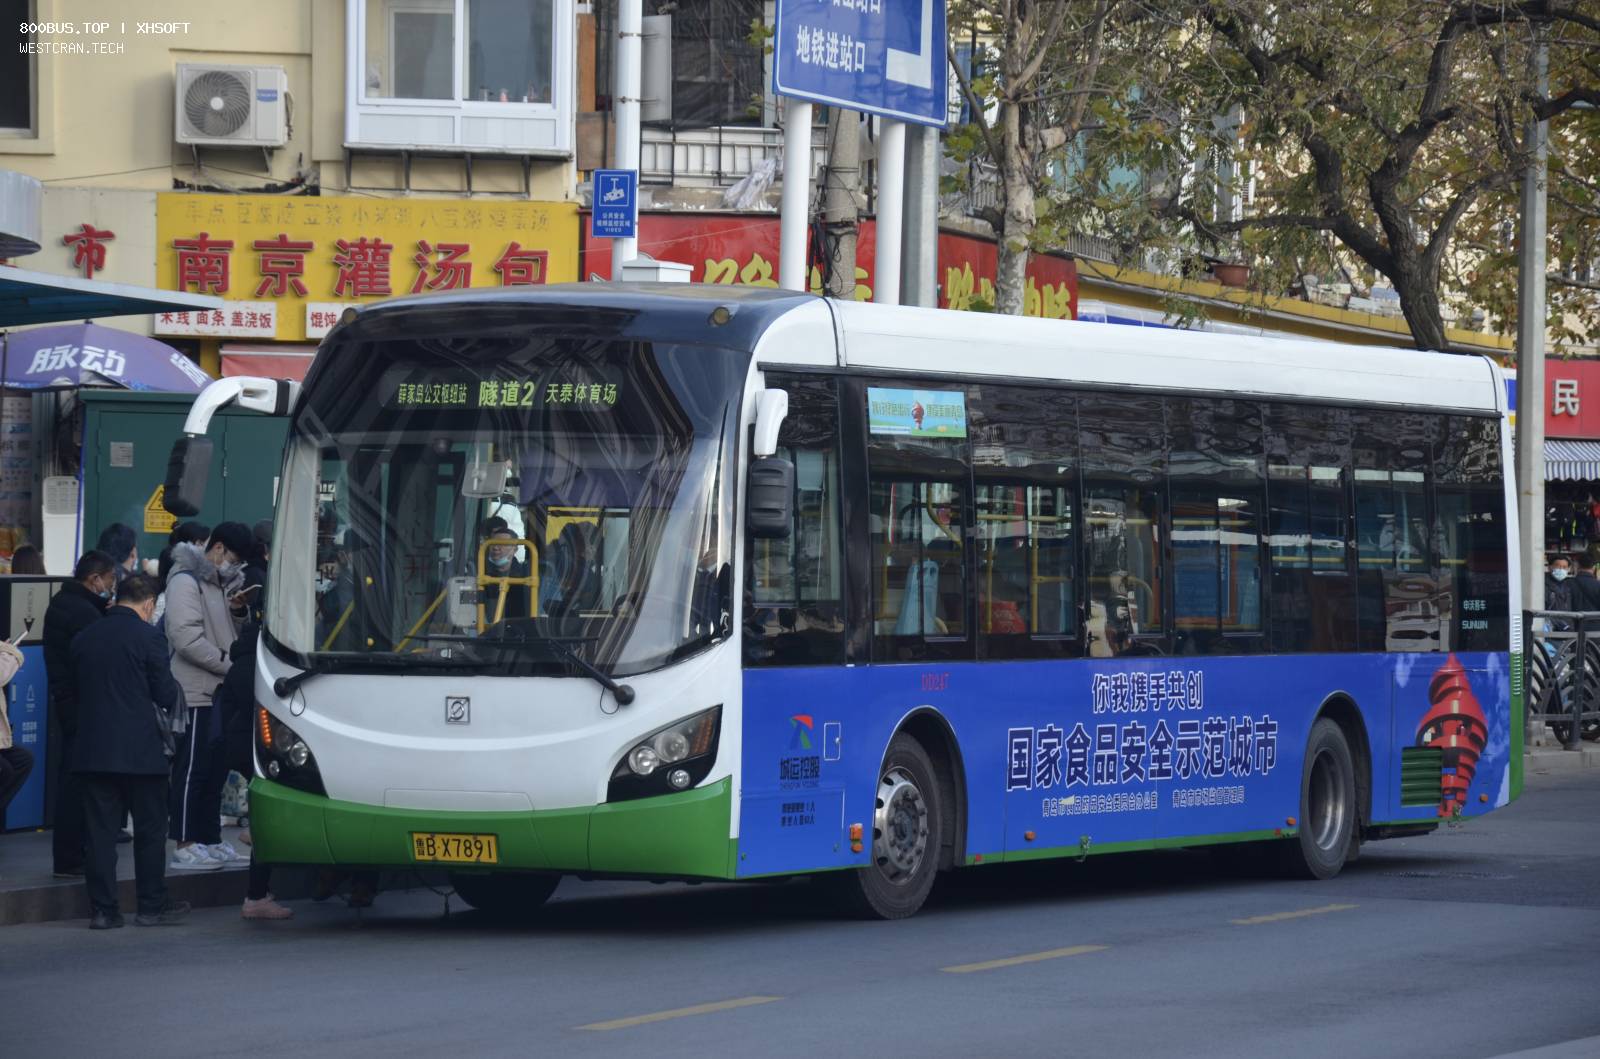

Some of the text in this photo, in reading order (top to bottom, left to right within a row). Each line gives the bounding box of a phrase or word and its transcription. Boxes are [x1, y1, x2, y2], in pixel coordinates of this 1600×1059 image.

[796, 24, 866, 73] 地铁进站口
[62, 223, 116, 280] 市
[172, 231, 549, 298] 南京灌汤包
[196, 309, 226, 327] 面条
[231, 311, 272, 329] 盖浇饭
[26, 343, 127, 378] 脉动
[478, 380, 536, 407] 隧道2
[545, 382, 617, 404] 天泰体育场
[1554, 379, 1580, 416] 民
[1462, 620, 1488, 630] SUNWIN
[1092, 670, 1203, 714] 你我携手共创
[1006, 715, 1279, 792] 国家食品安全示范城市
